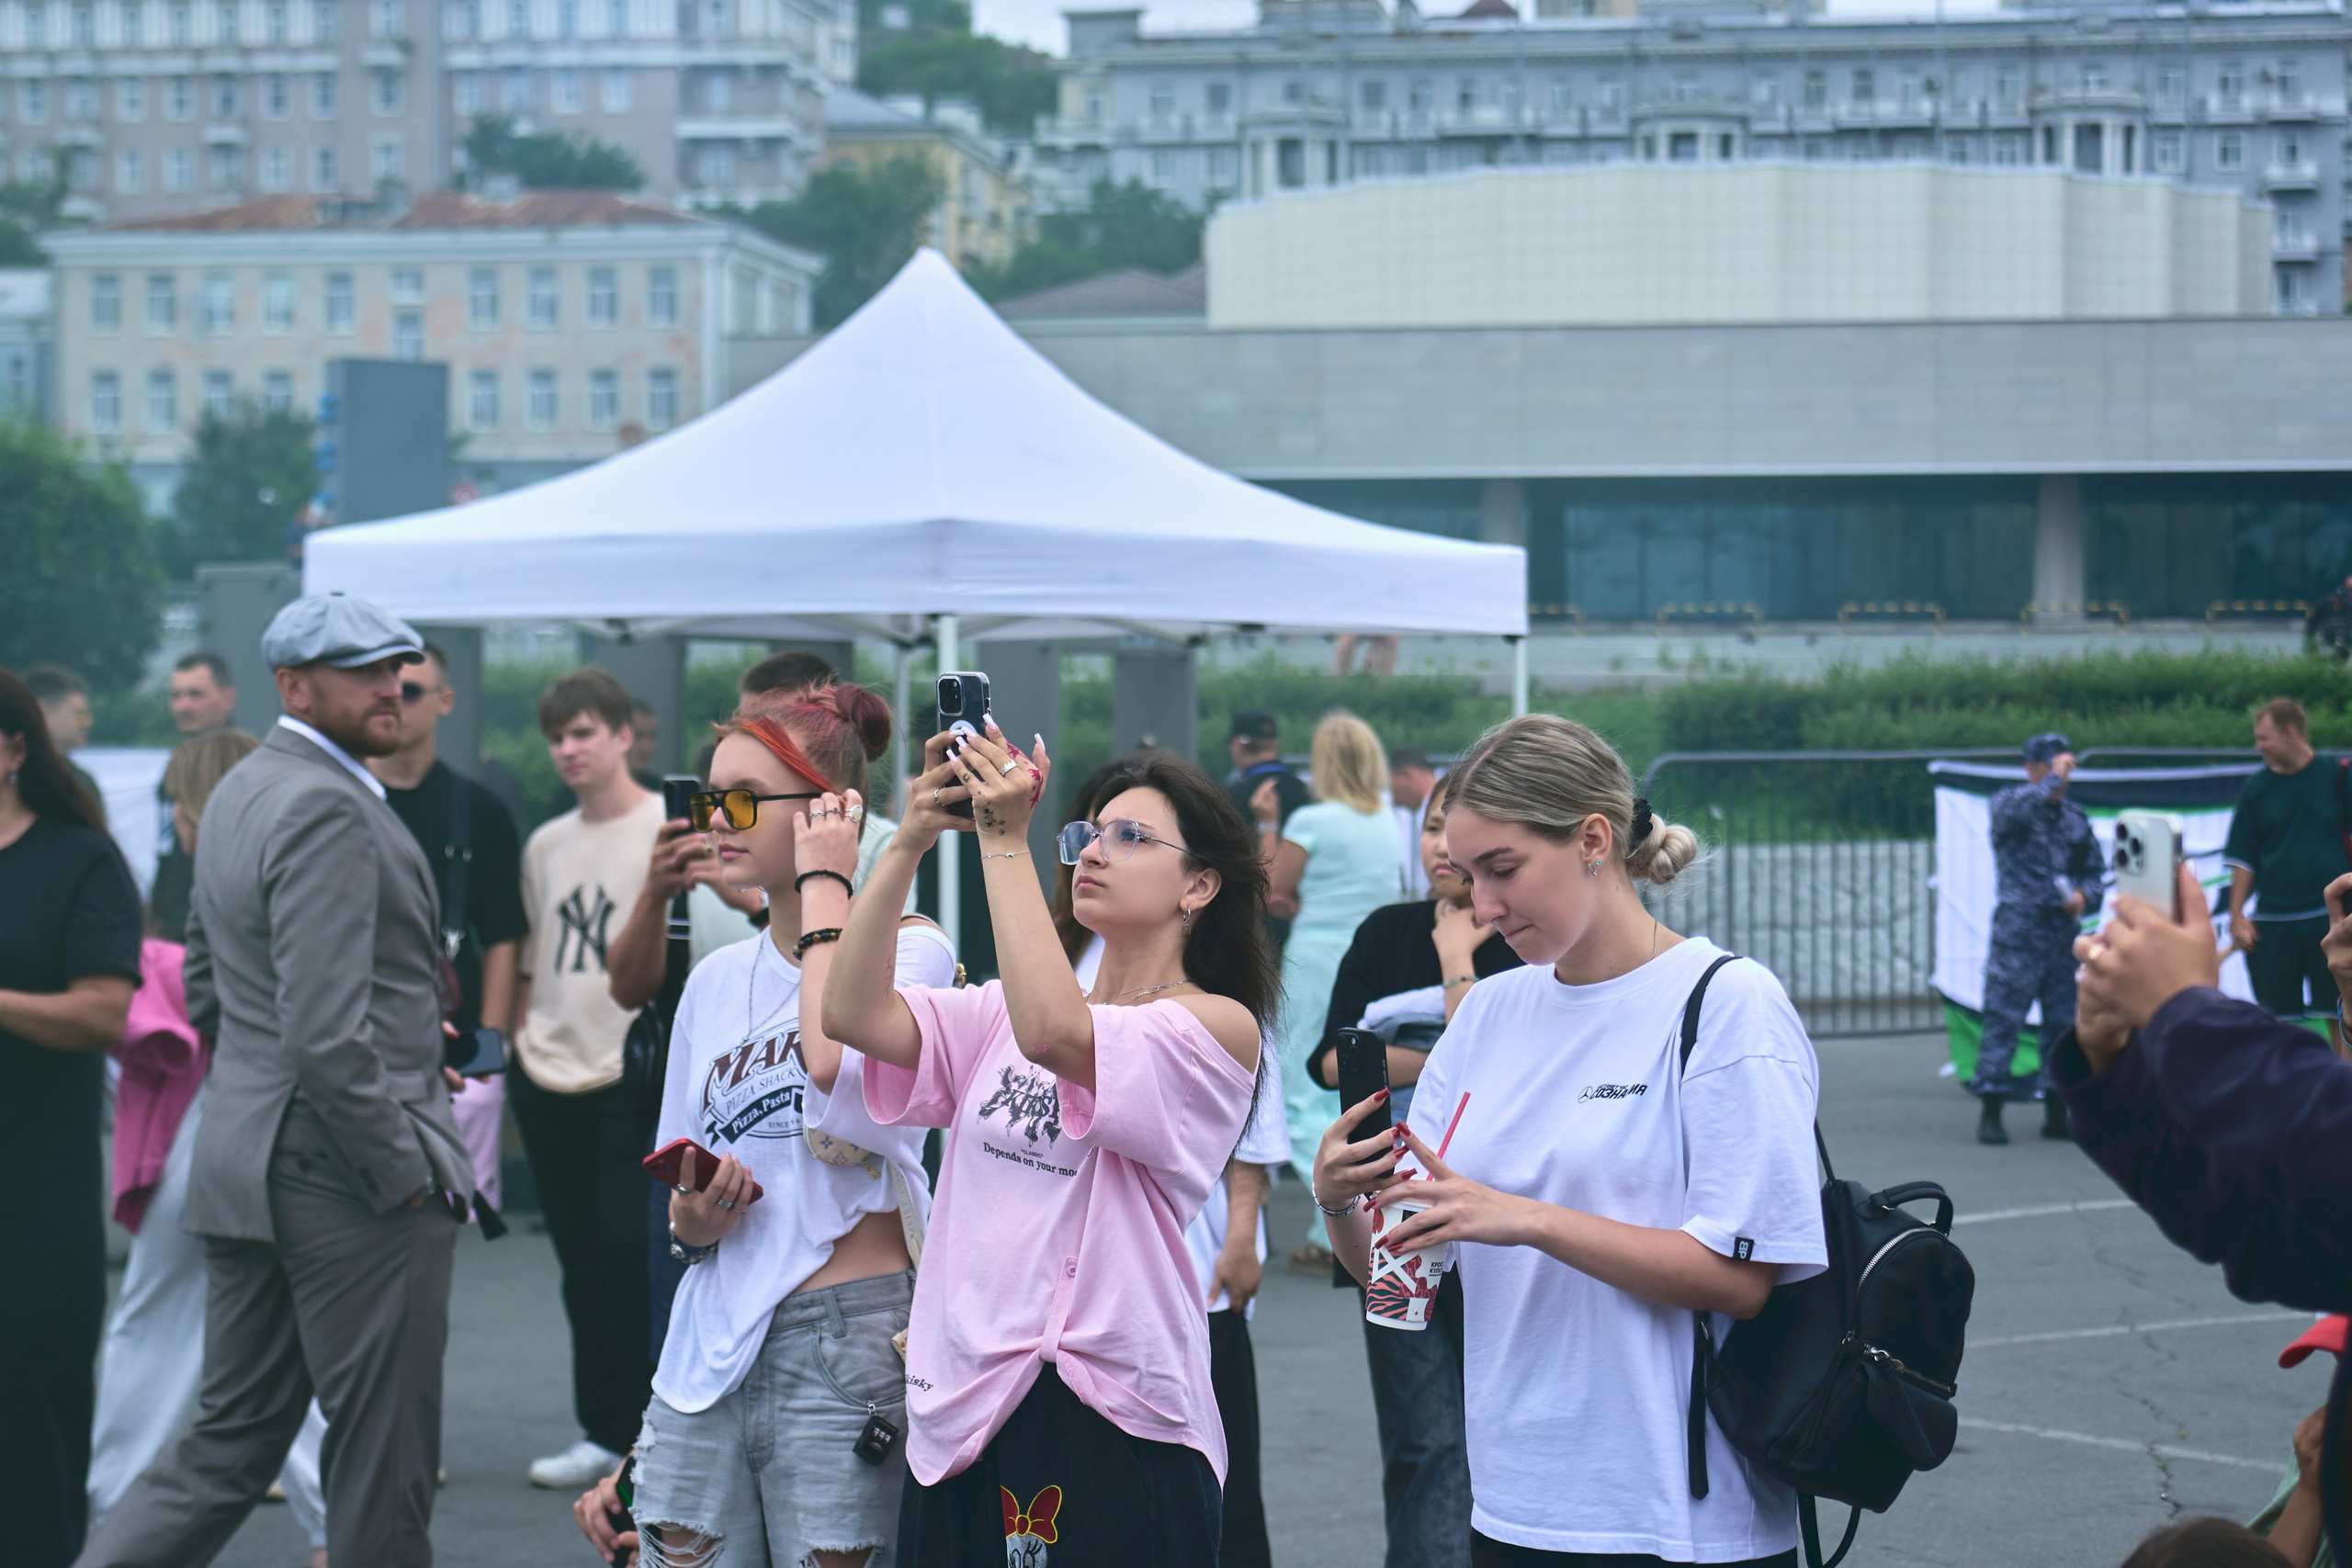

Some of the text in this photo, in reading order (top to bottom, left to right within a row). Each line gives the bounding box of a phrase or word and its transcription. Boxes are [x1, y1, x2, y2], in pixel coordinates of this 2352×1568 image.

[702, 1030, 808, 1113] MAR
[727, 1067, 797, 1114] PIZZA SHACK
[731, 1089, 791, 1134] Pizza, Pasta
[768, 1121, 789, 1129] SINCE
[983, 1142, 1022, 1163] Depends
[1023, 1157, 1035, 1167] on
[1036, 1161, 1057, 1173] your
